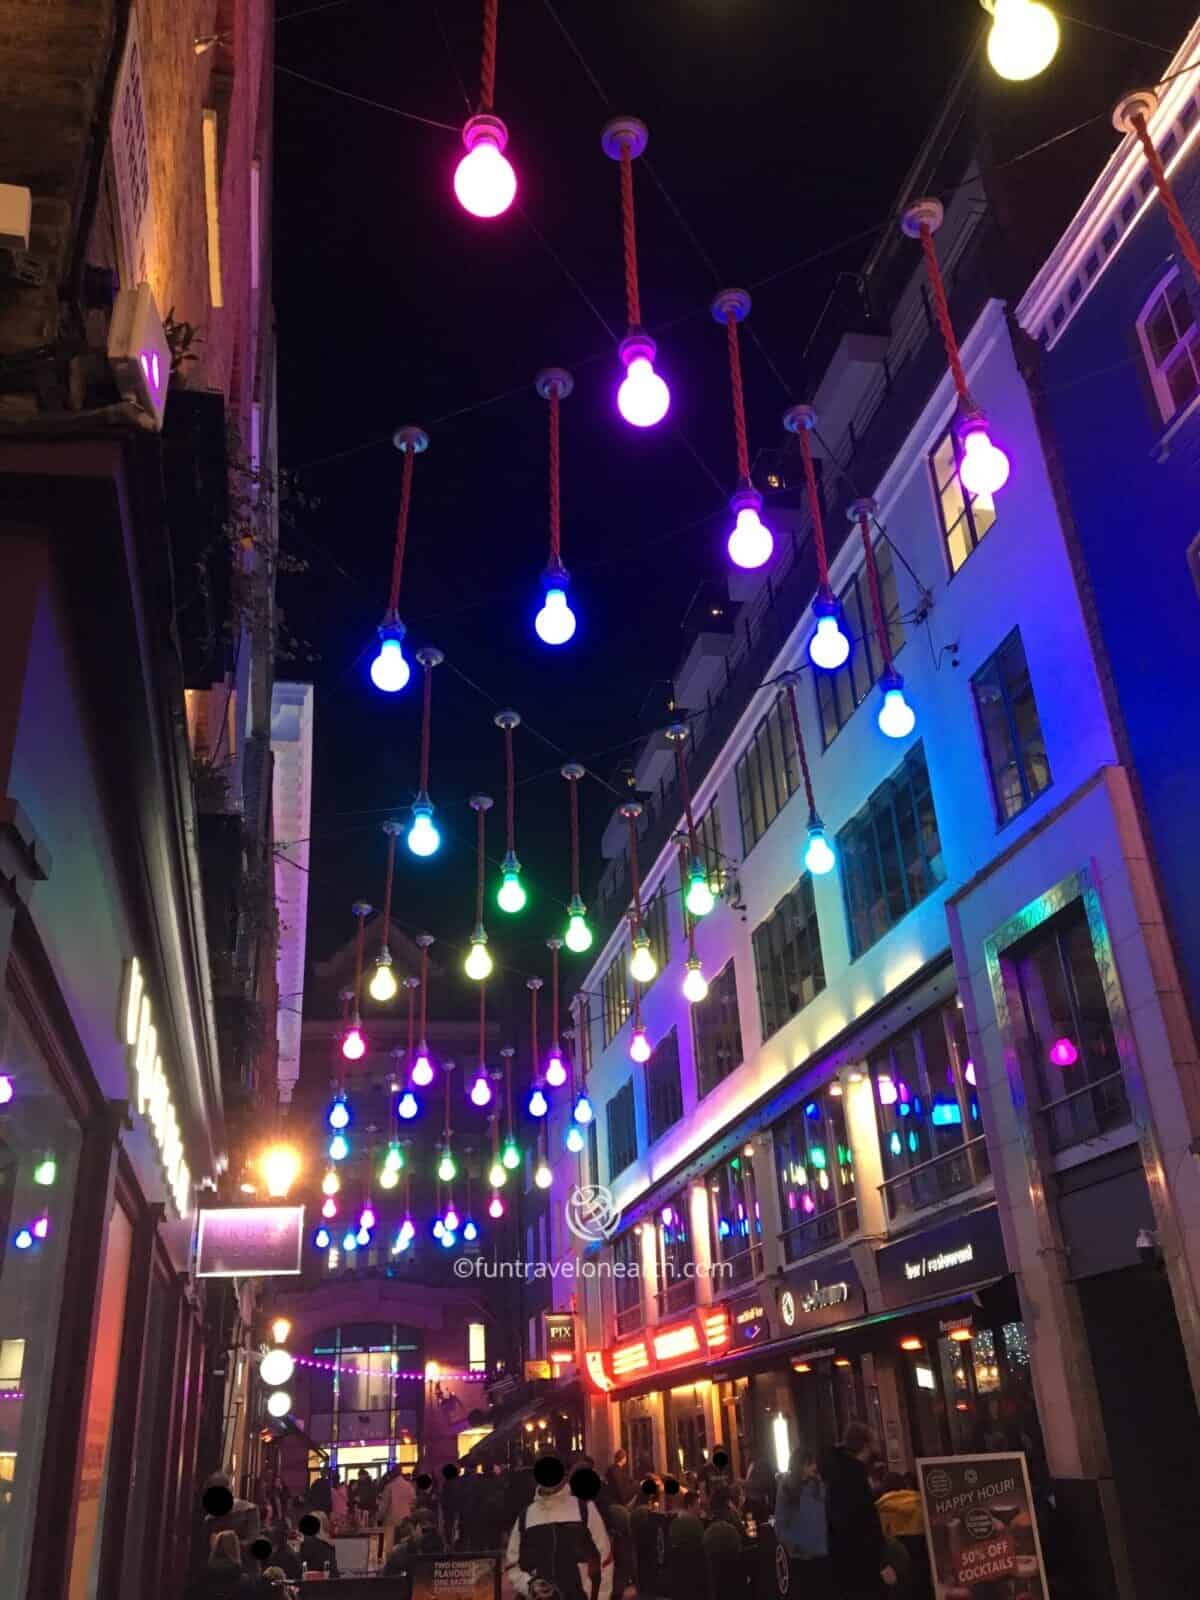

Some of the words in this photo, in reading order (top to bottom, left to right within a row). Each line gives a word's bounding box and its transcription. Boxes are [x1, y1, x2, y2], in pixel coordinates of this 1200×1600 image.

[550, 1327, 571, 1338] PIX
[936, 1490, 973, 1513] HAPPY
[977, 1478, 1015, 1499] HOUR!
[961, 1548, 986, 1567] 50%
[987, 1541, 1009, 1557] OFF
[958, 1556, 1015, 1582] COCKTAILS
